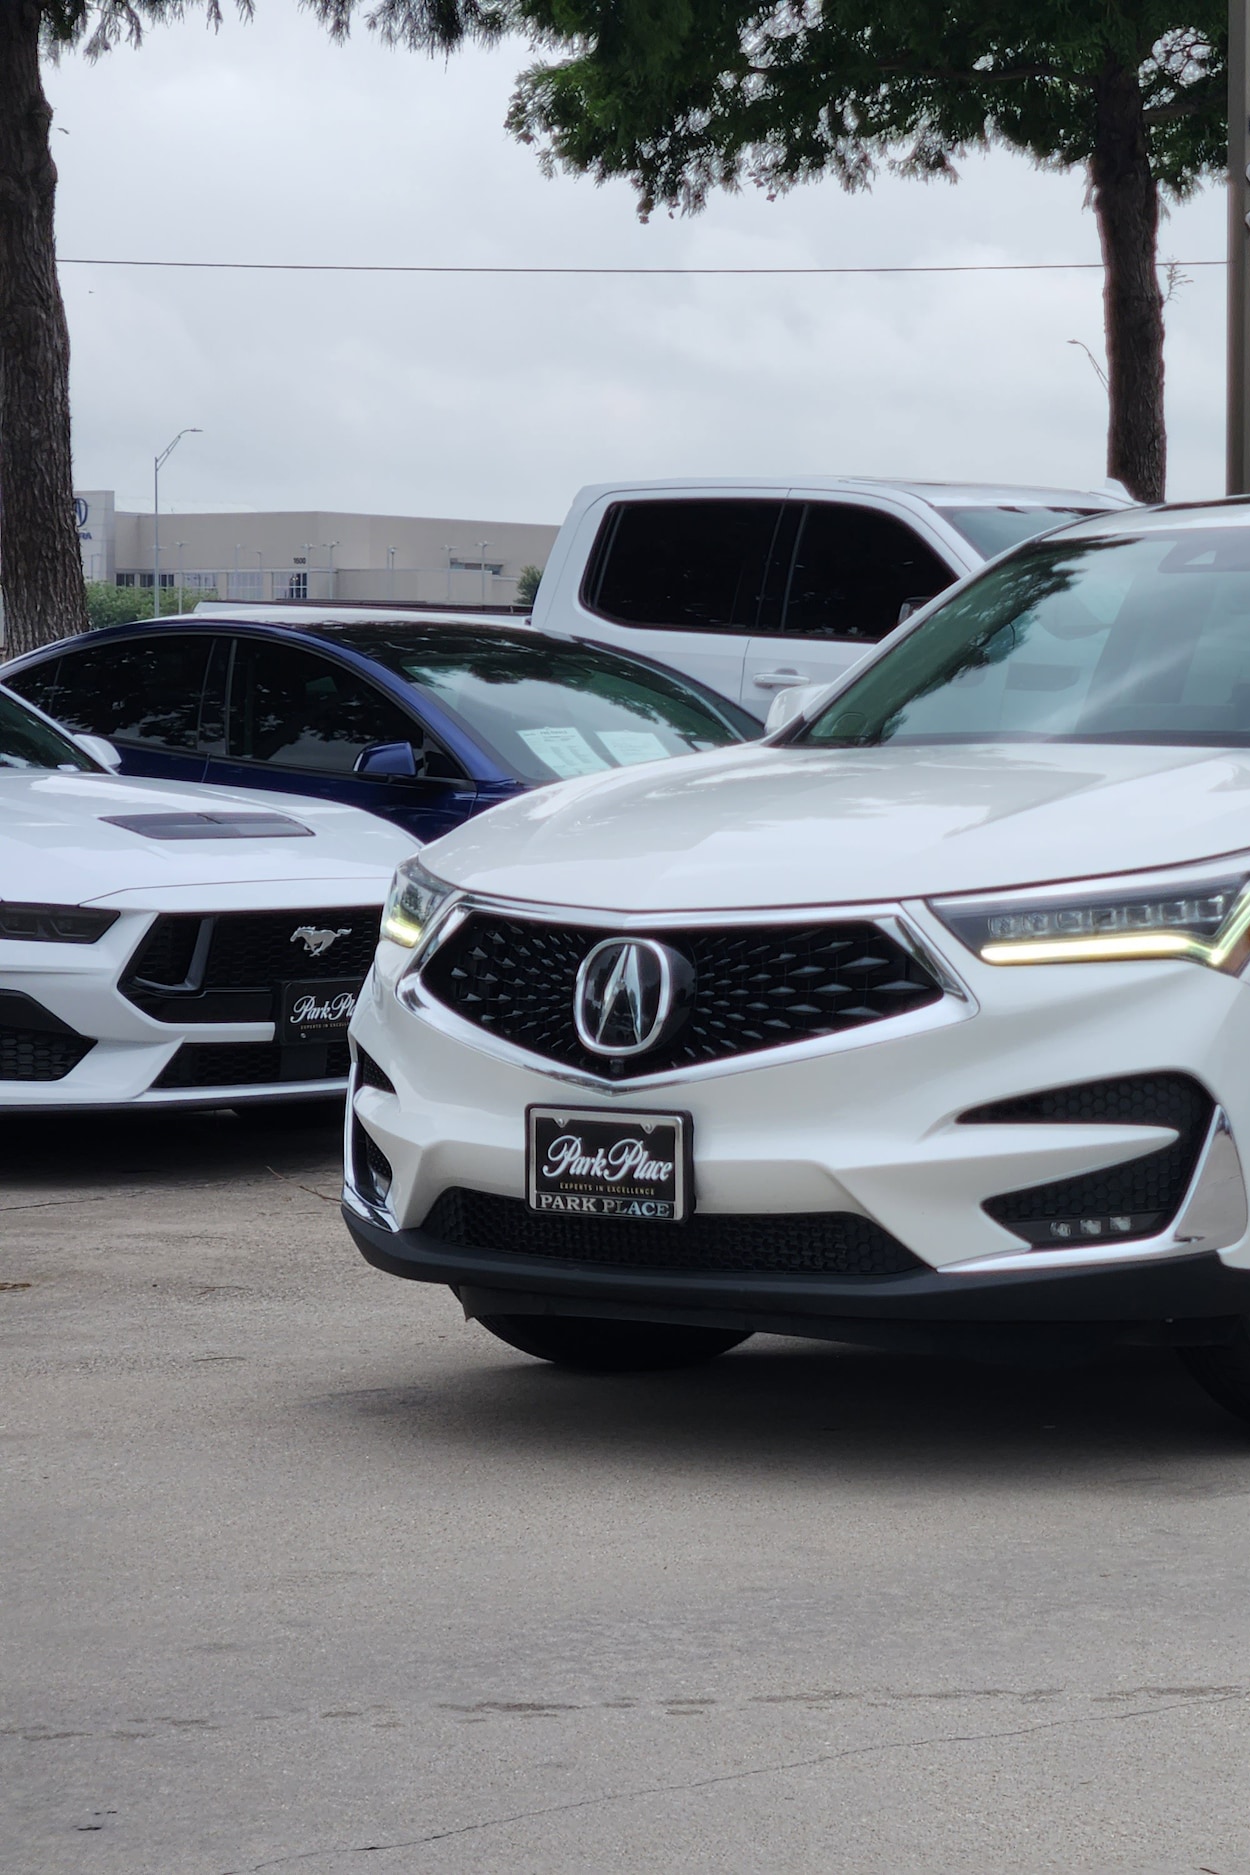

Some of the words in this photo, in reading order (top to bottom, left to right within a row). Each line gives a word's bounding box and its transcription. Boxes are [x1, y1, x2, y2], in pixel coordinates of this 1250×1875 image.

[290, 995, 331, 1023] Park
[542, 1135, 607, 1178] Park
[604, 1138, 673, 1182] Place
[559, 1182, 593, 1191] EXPERTS
[607, 1185, 655, 1196] EXCELLENCE
[540, 1194, 597, 1212] PARK
[602, 1199, 670, 1216] PLACE
